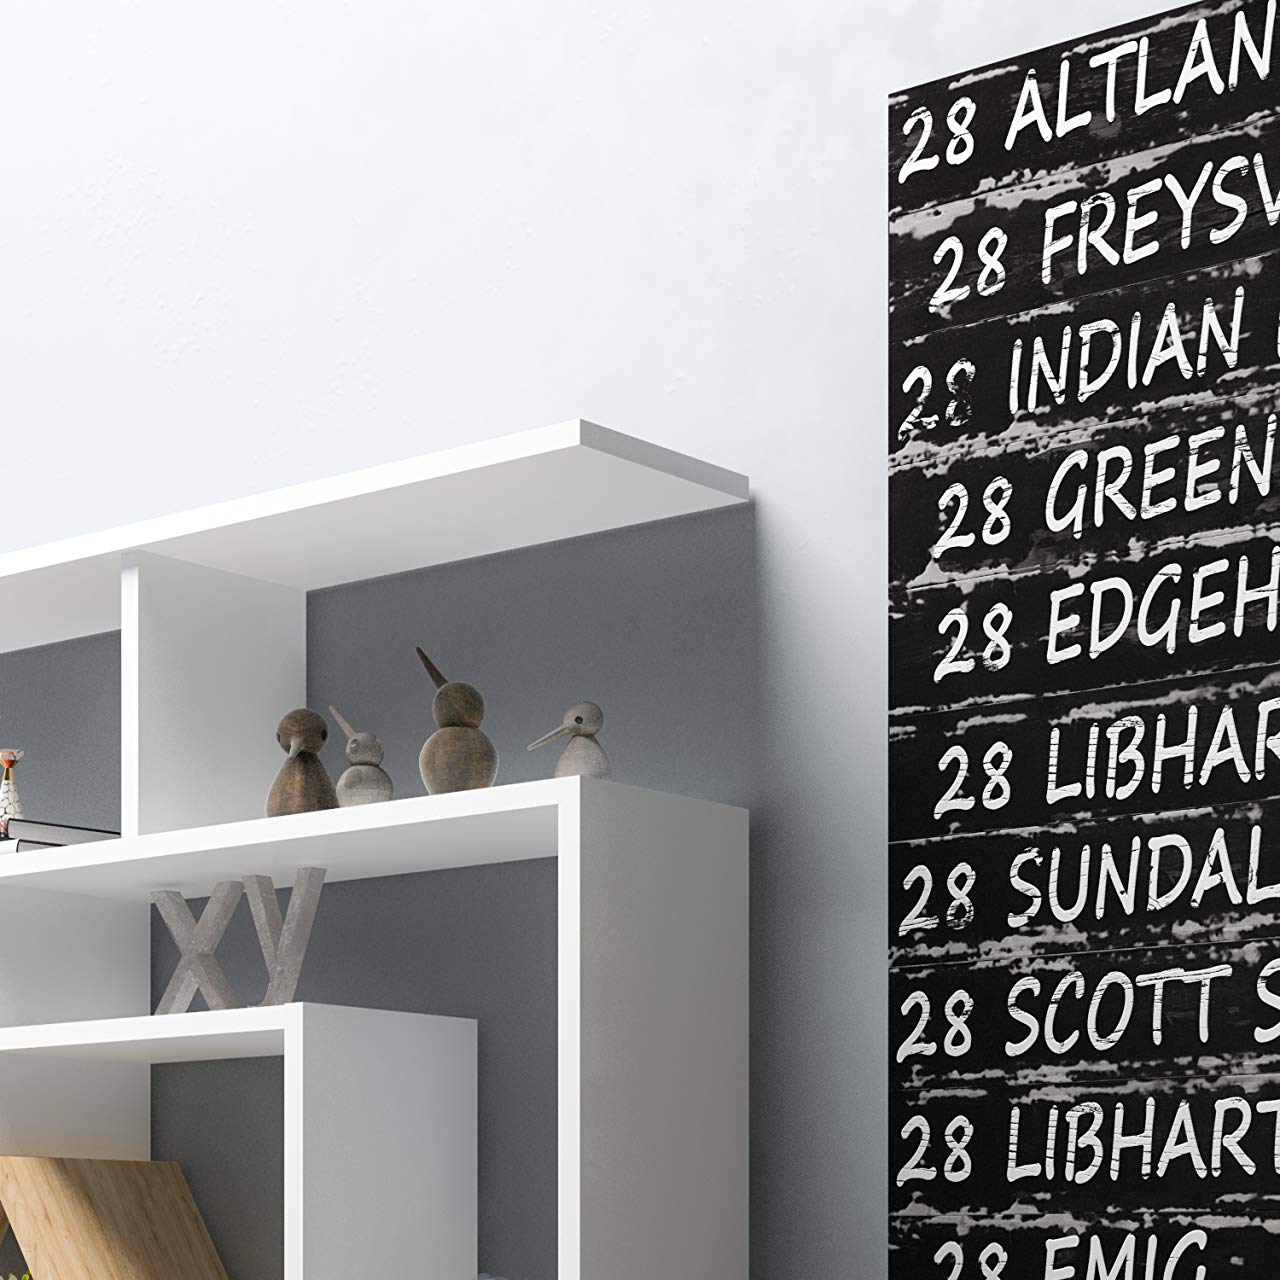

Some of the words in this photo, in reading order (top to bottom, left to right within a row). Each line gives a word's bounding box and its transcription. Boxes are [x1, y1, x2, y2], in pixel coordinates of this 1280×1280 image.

[899, 97, 977, 183] 28
[1005, 0, 1277, 150] ALTLAN
[928, 226, 1008, 313] 28
[898, 357, 977, 441] 28
[1009, 286, 1245, 414] INDIAN
[932, 476, 1013, 559] 28
[1045, 413, 1277, 539] GREEN
[933, 602, 1013, 683] 28
[1046, 546, 1280, 664] EDGEH
[933, 741, 1013, 819] 28
[898, 862, 977, 936] 28
[1007, 825, 1280, 928] SUNDAL
[896, 989, 975, 1063] 28
[1005, 964, 1233, 1057] SCOTT
[896, 1115, 975, 1187] 28
